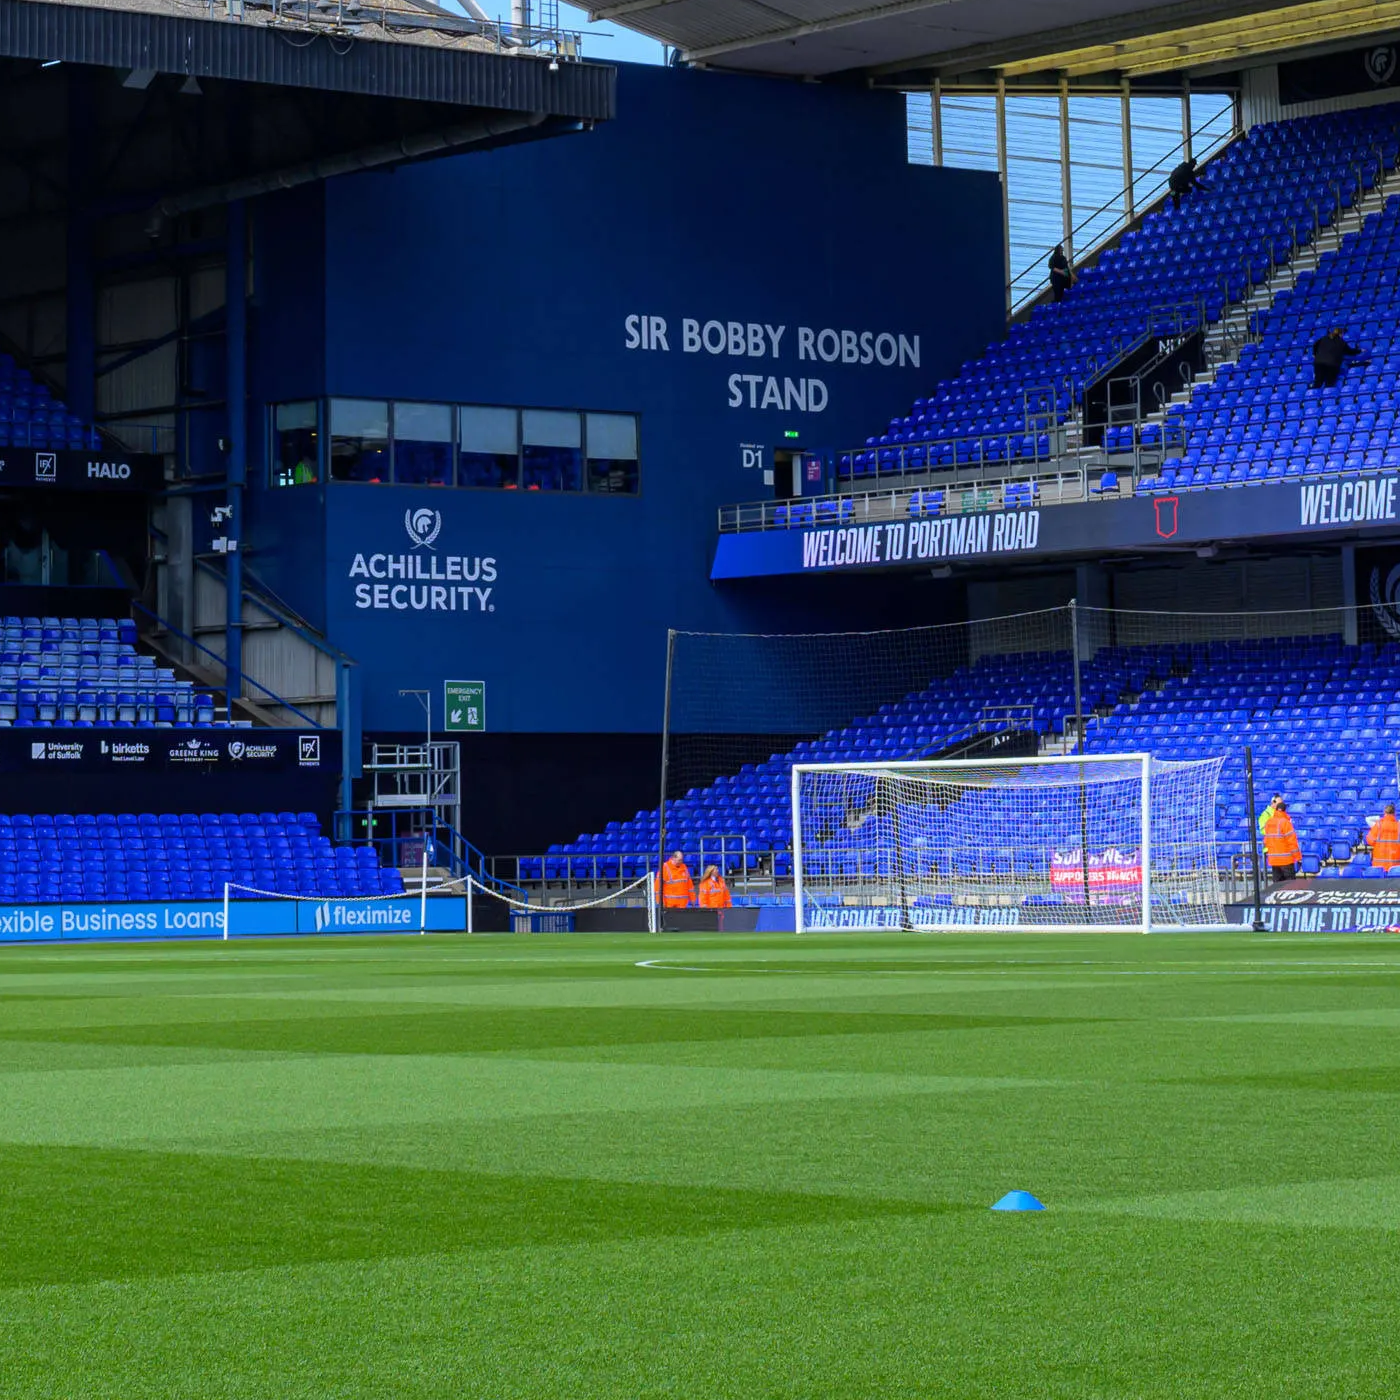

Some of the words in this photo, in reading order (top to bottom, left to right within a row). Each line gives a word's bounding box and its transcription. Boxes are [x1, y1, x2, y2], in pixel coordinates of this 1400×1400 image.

[625, 314, 669, 350] SIR
[682, 319, 786, 359] BOBBY
[798, 326, 920, 369] ROBSON
[728, 373, 828, 412] STAND
[742, 449, 762, 468] D1
[87, 461, 130, 478] HALO
[1300, 477, 1397, 525] WELCOME
[803, 525, 881, 568] WELCOME
[884, 523, 903, 561] TO
[908, 514, 989, 560] PORTMAN
[993, 510, 1040, 552] ROAD
[349, 553, 497, 582] ACHILLEUS
[48, 742, 83, 753] University
[48, 750, 57, 759] of
[59, 750, 81, 759] Suffolk
[113, 742, 149, 755] birketts
[170, 749, 197, 757] GREENE
[200, 749, 219, 758] KING
[246, 745, 276, 753] ACHILLEUS
[1053, 849, 1100, 865] SOUH
[62, 910, 157, 933] Business
[164, 908, 225, 930] Loans
[334, 906, 411, 927] fleximize
[1330, 908, 1351, 930] TO
